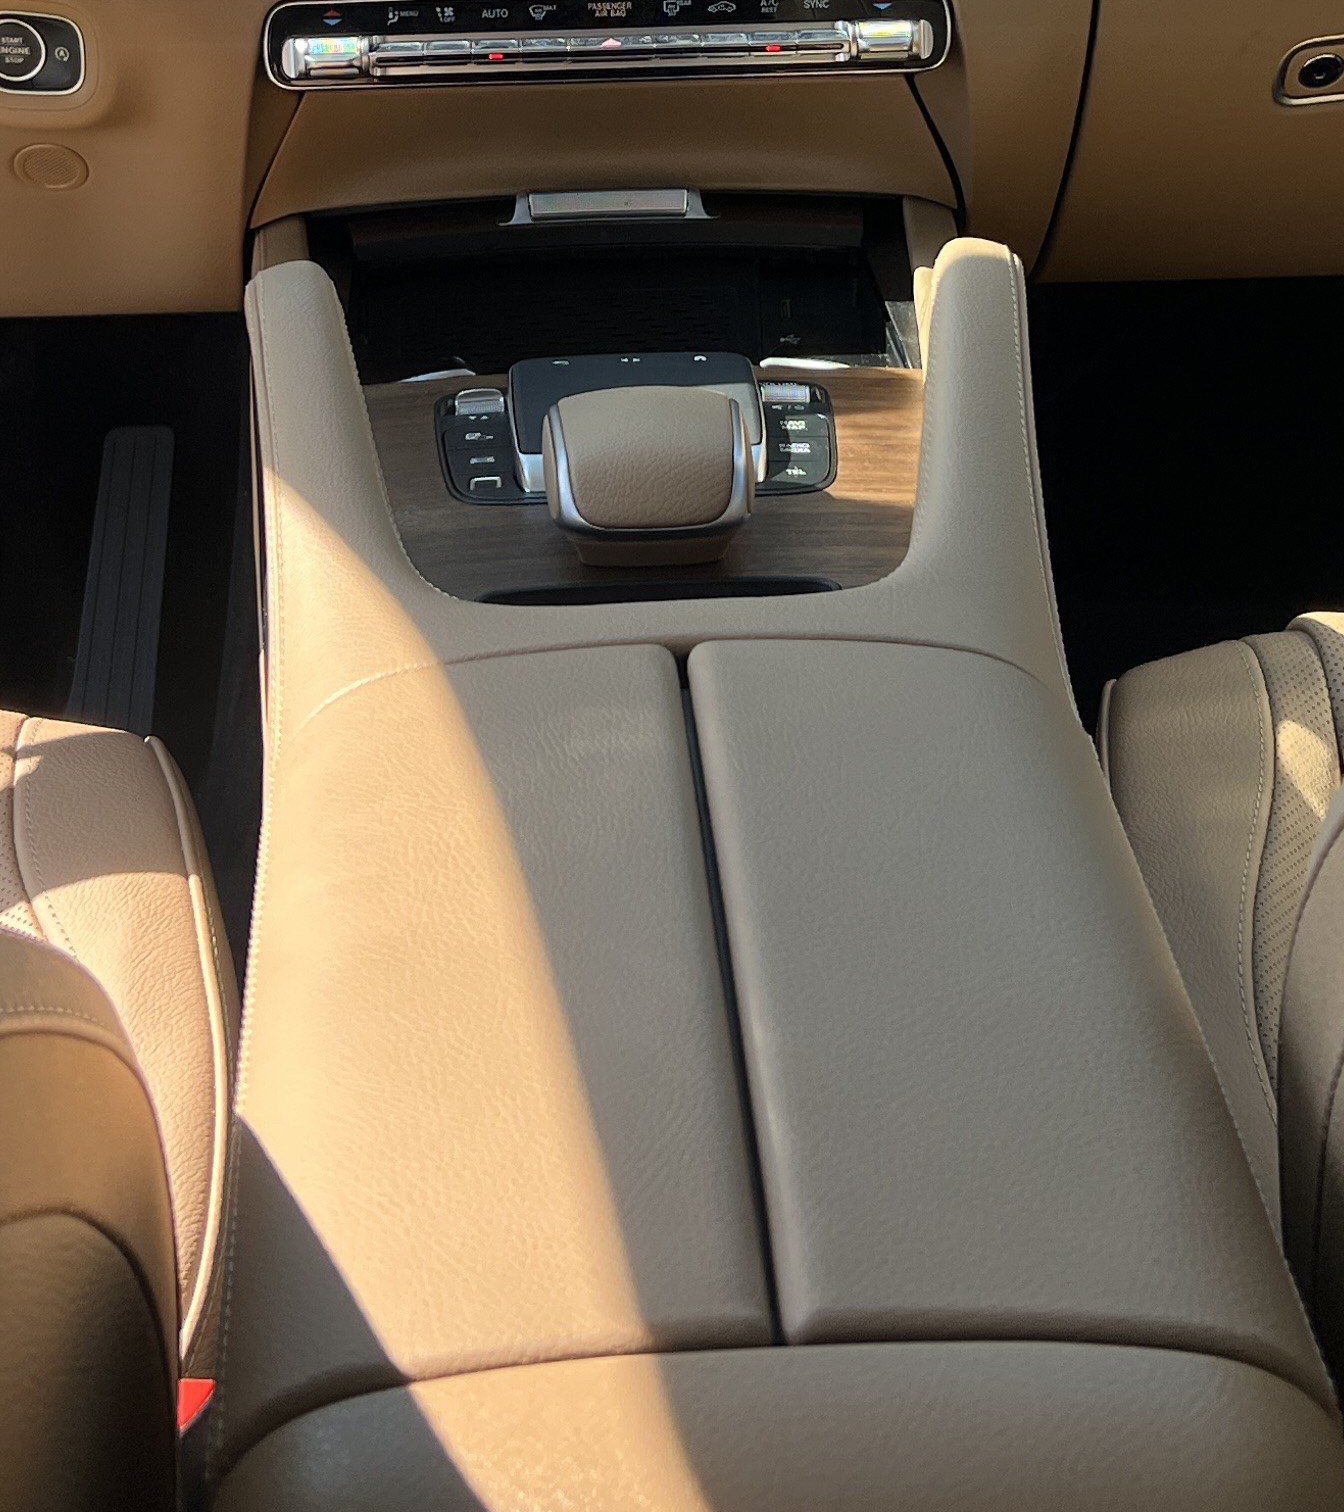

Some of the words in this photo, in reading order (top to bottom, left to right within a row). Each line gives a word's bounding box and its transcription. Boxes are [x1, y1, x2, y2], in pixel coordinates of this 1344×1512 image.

[587, 1, 633, 11] PASSENGER
[803, 0, 830, 9] SYNC
[482, 8, 509, 19] AUTO
[595, 10, 608, 18] AIR
[610, 10, 627, 18] BAG
[1, 36, 23, 44] START
[4, 56, 25, 64] STOP
